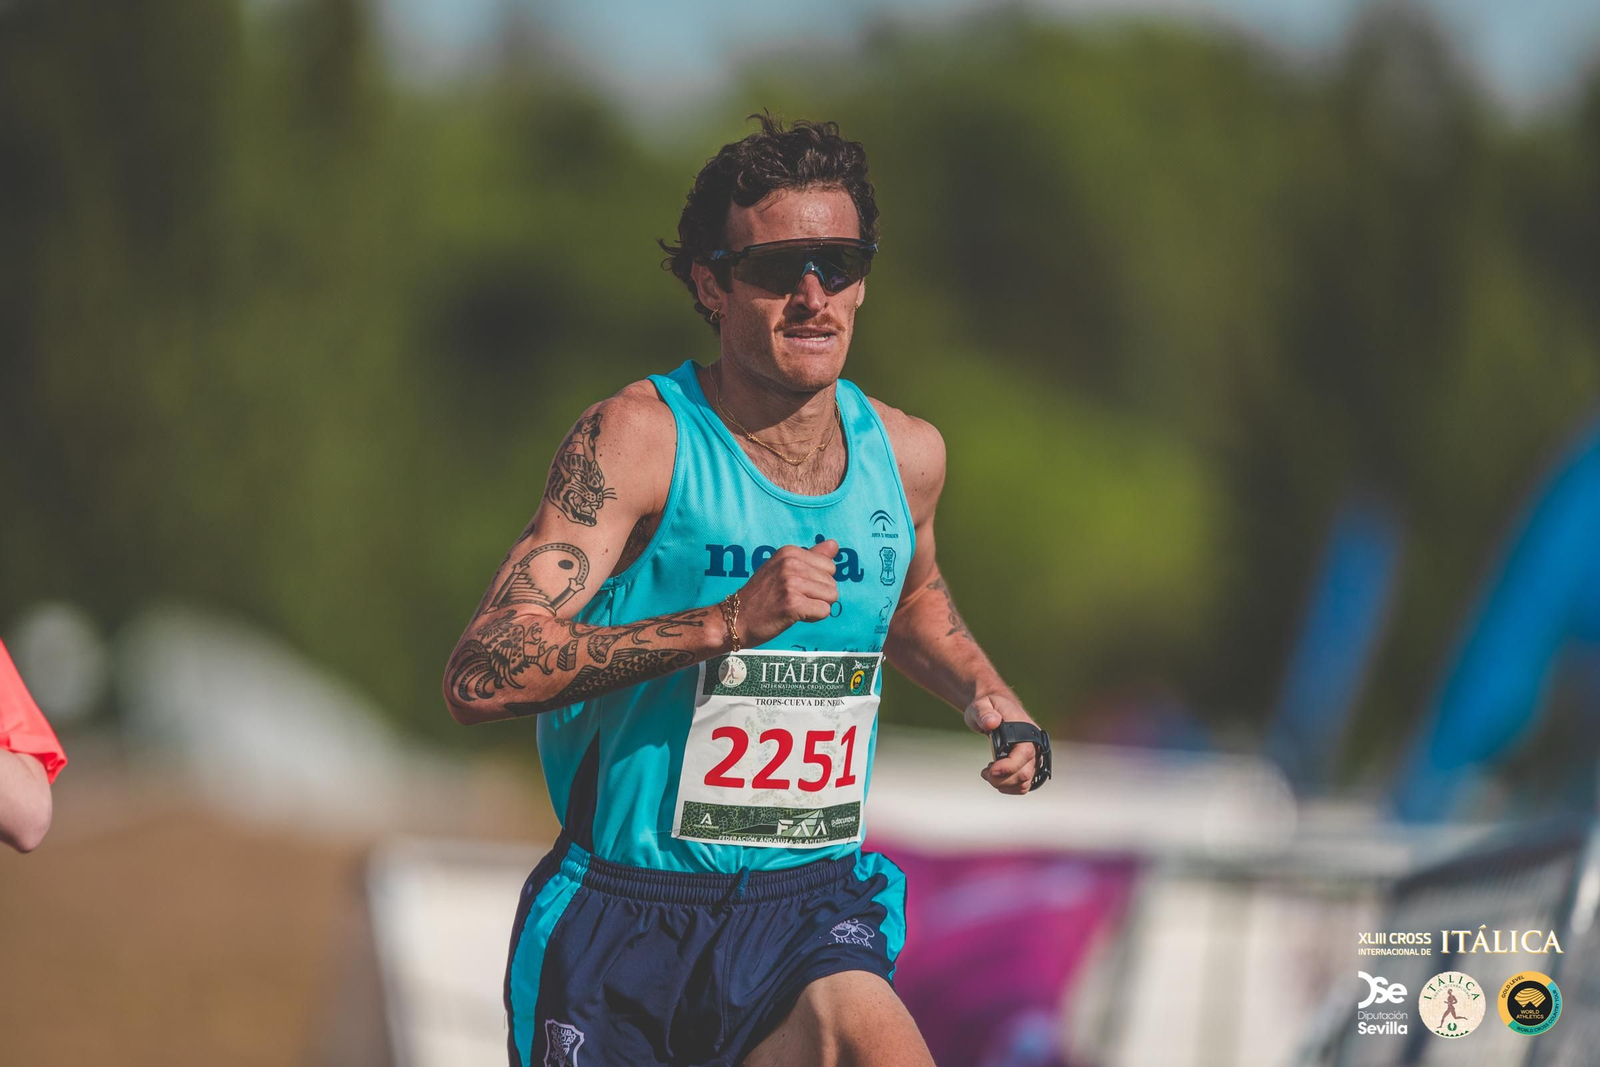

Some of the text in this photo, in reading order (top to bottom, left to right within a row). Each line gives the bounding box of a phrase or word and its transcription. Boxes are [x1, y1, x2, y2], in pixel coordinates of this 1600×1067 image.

[761, 658, 845, 684] ITÁLICA
[755, 698, 812, 707] TROPS-CUEVA
[814, 699, 825, 707] DE
[704, 725, 857, 793] 2251
